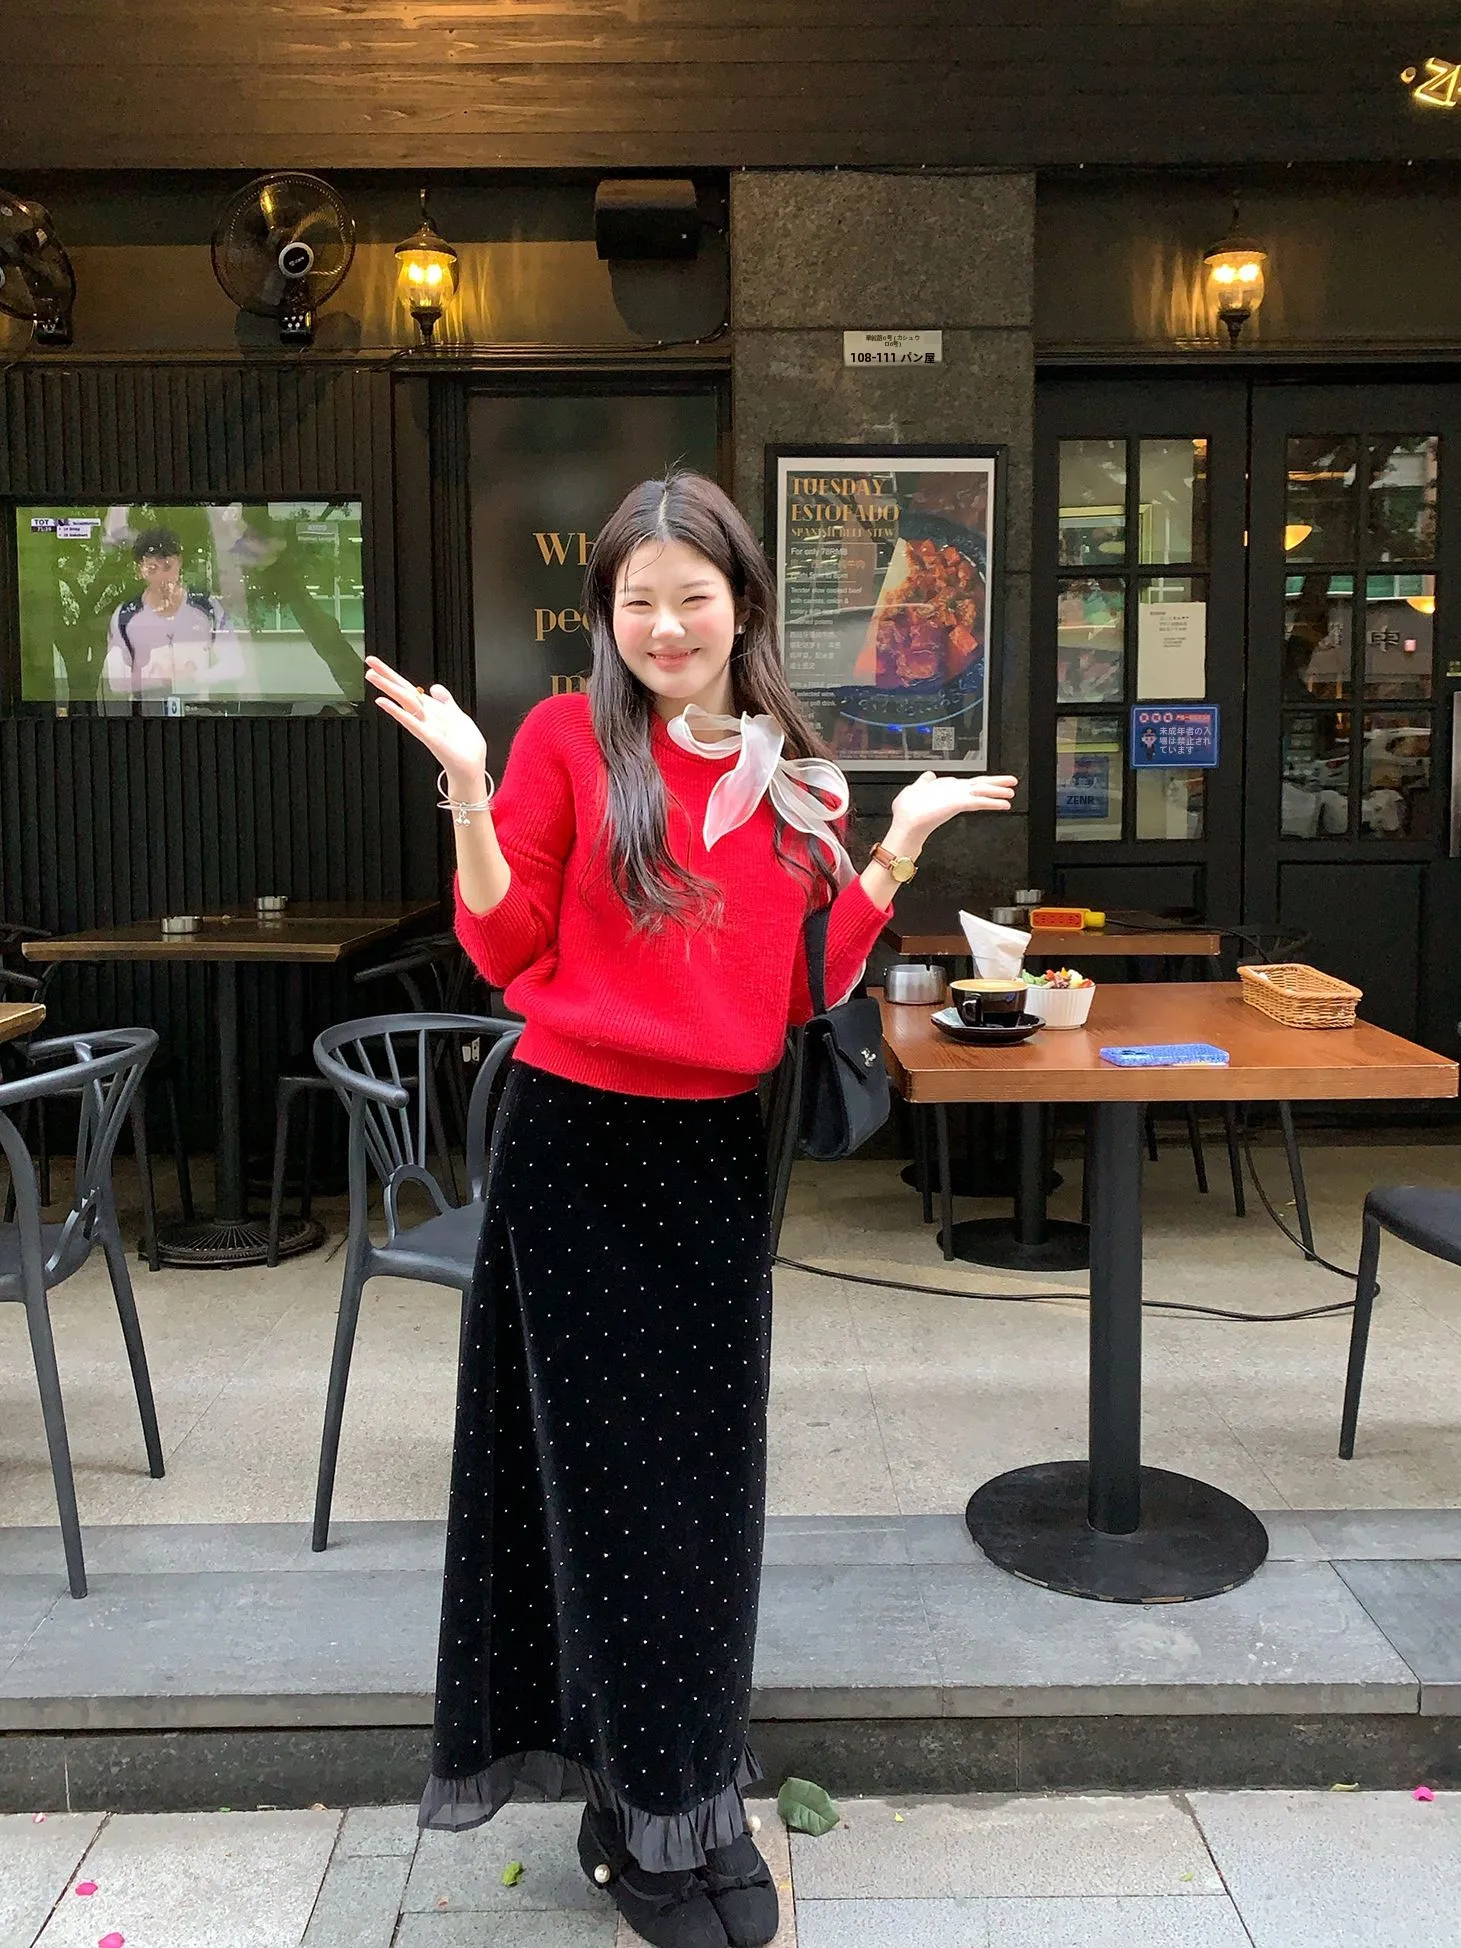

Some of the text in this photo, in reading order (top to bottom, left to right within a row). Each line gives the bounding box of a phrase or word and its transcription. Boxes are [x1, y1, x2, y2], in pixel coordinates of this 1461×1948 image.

[850, 351, 936, 364] 108-111 パン屋
[792, 478, 883, 496] TUESDAY
[791, 503, 901, 522] ESTOFADO
[867, 527, 893, 538] STEW
[532, 532, 596, 566] Wh
[791, 547, 803, 556] For
[804, 547, 819, 557] only
[1159, 726, 1212, 736] 未成年者の入
[1159, 736, 1212, 746] 場は禁止され
[1159, 745, 1194, 755] ています
